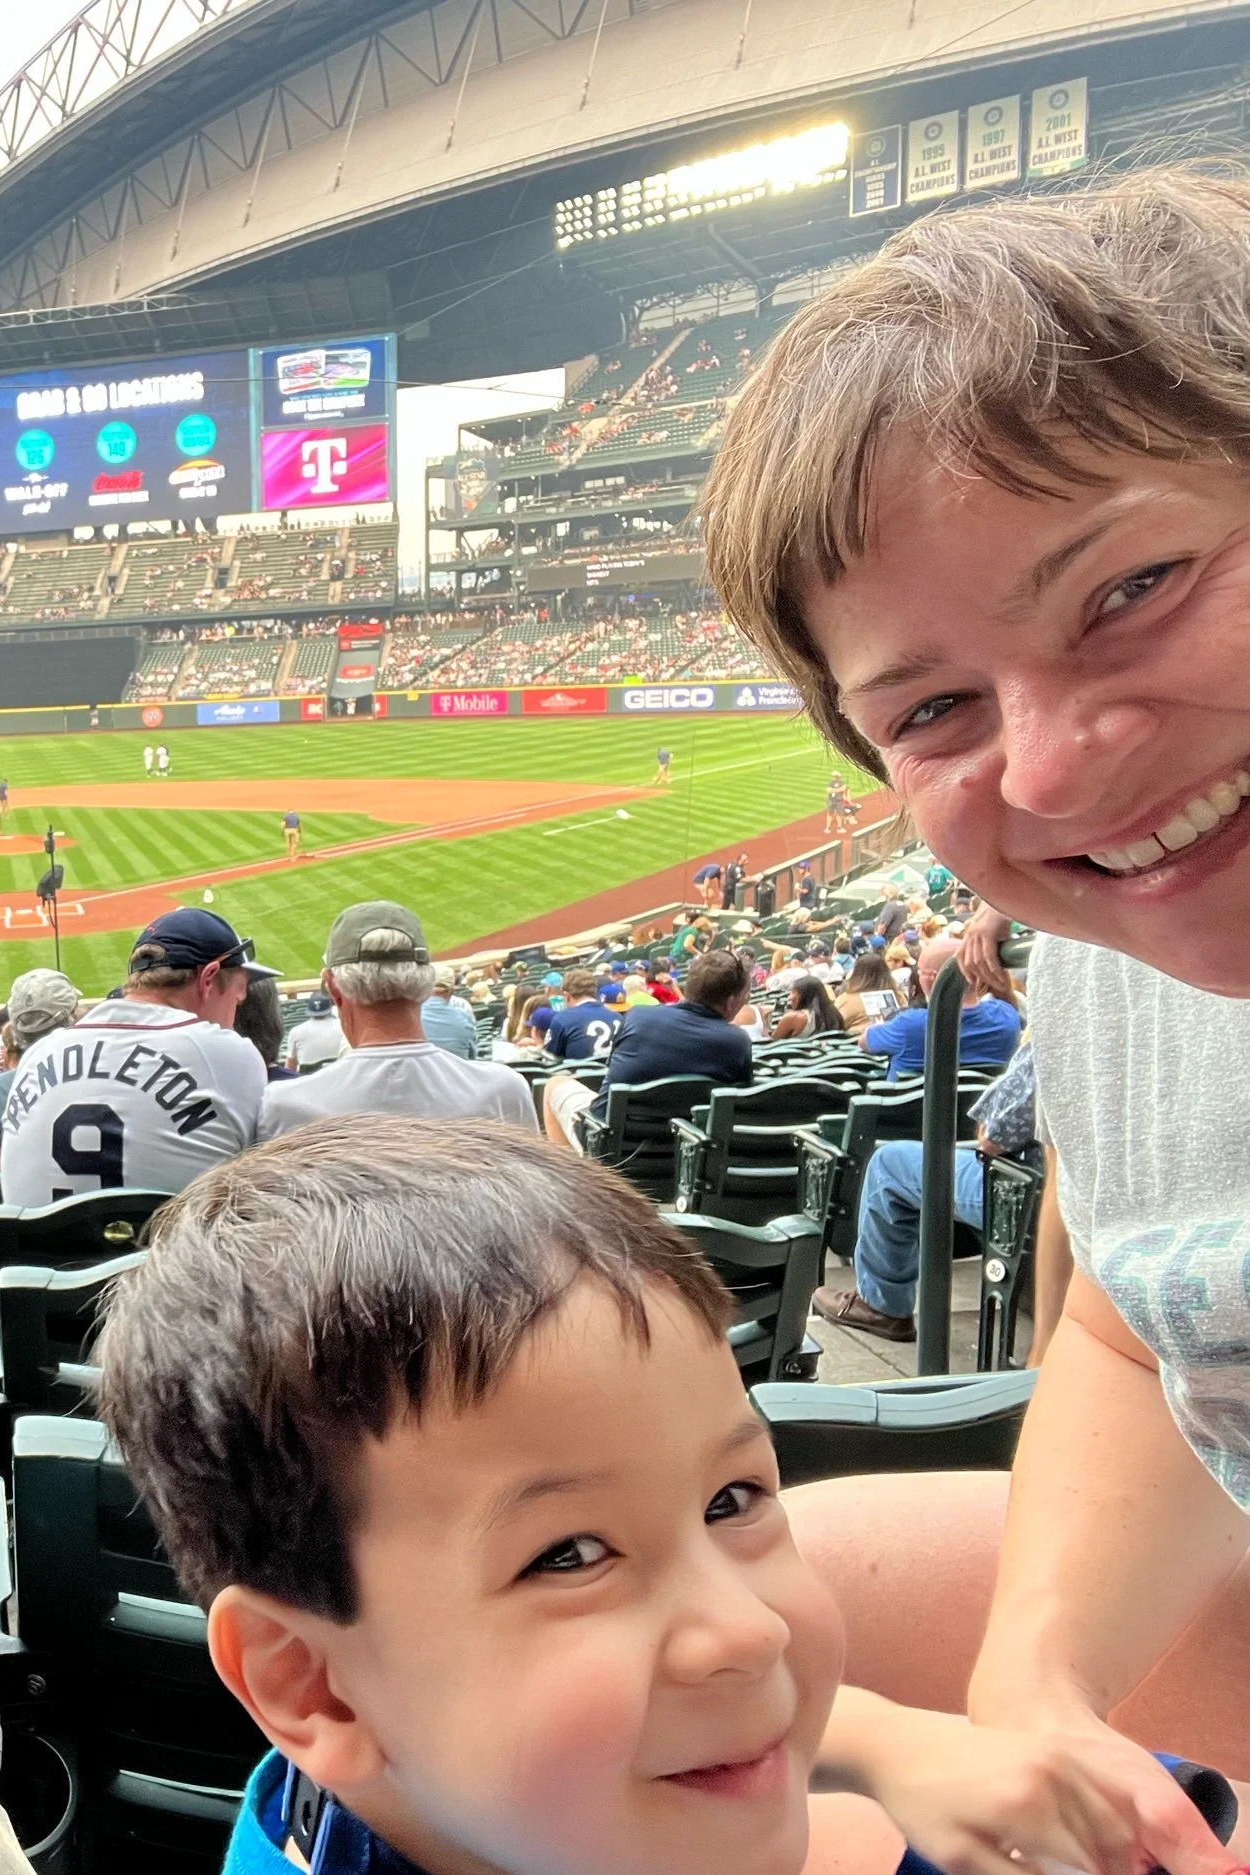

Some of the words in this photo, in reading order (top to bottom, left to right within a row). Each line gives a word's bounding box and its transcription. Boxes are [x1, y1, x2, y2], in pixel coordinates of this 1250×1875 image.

[1046, 113, 1071, 131] 2001
[982, 129, 1005, 146] 1997
[1054, 129, 1078, 146] WEST
[922, 144, 945, 160] 1995
[989, 145, 1013, 161] WEST
[1032, 145, 1082, 166] CHAMPIONS
[930, 160, 952, 174] WEST
[969, 160, 1016, 181] CHAMPIONS
[910, 174, 955, 194] CHAMPIONS
[453, 694, 498, 711] Mobile
[624, 687, 714, 709] GEICO
[4, 1041, 217, 1136] PENDLETON
[52, 1103, 125, 1201] 9
[989, 1263, 1001, 1277] 30
